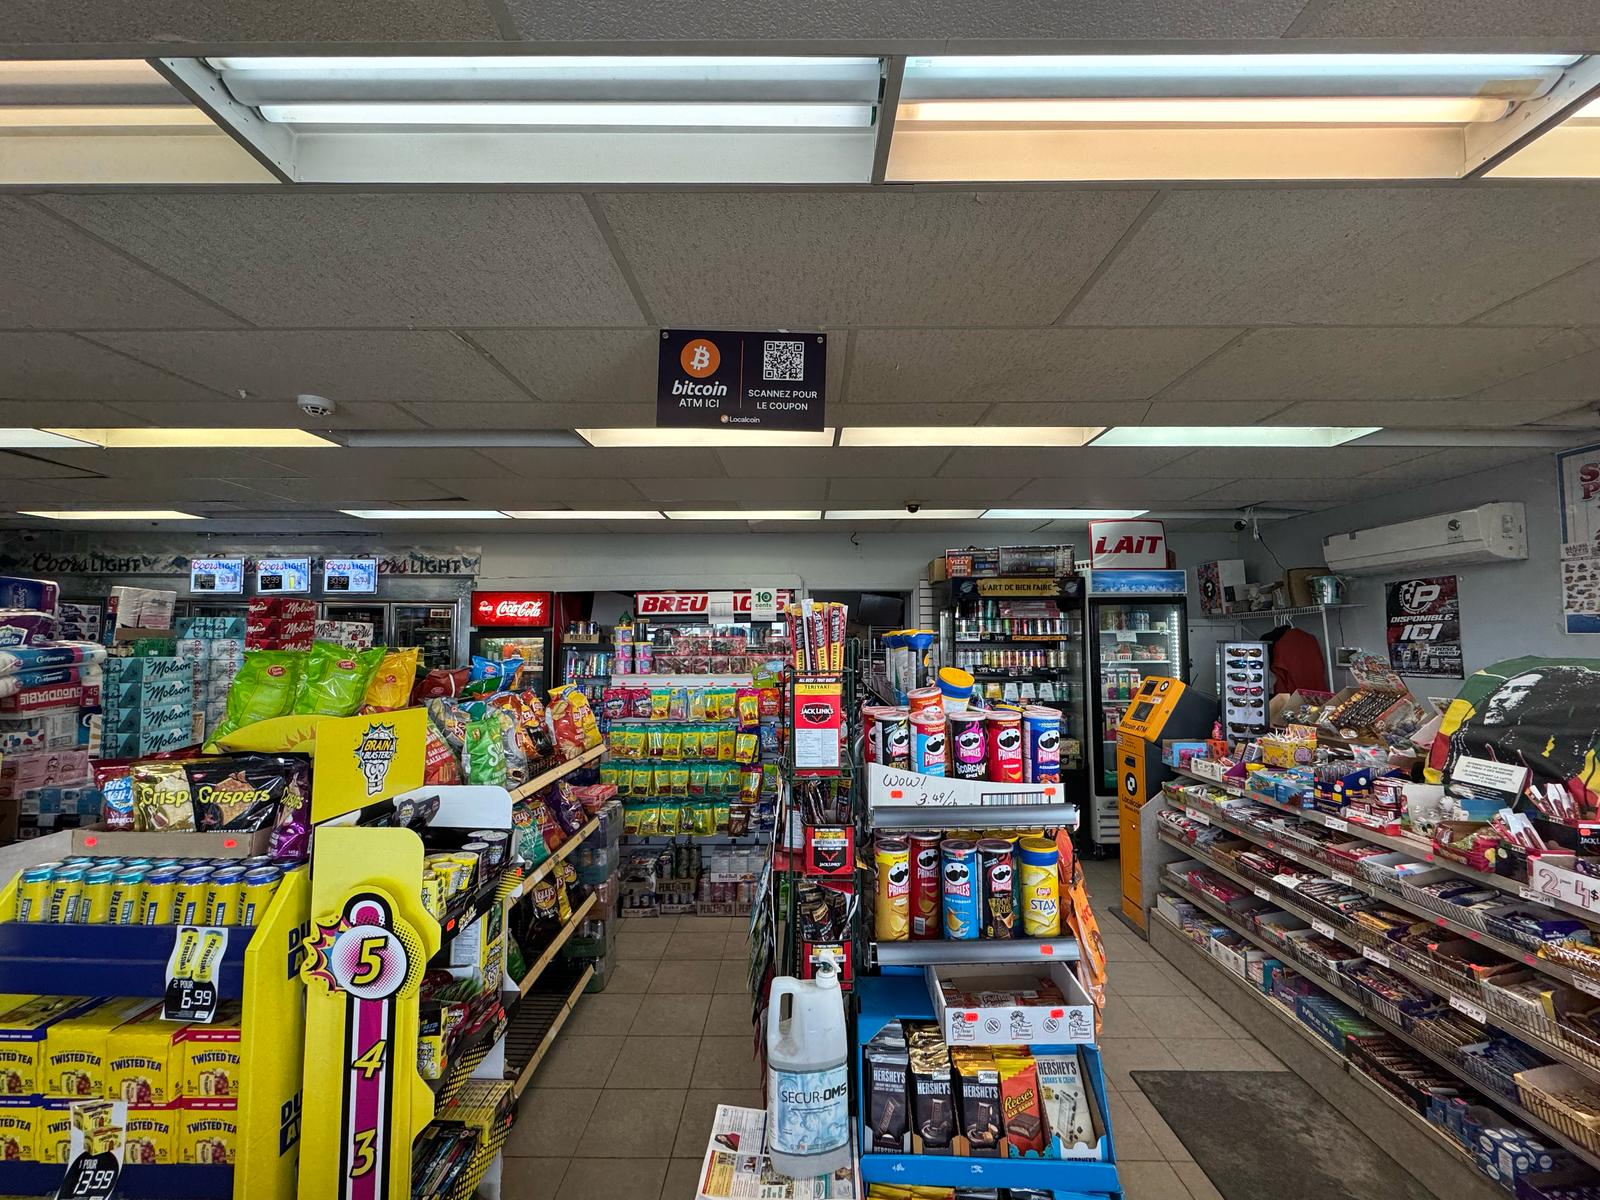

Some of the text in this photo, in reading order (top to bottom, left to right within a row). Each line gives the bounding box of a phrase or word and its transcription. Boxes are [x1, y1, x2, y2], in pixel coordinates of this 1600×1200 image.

[672, 380, 727, 396] bitcoin
[748, 390, 790, 398] SCANNEZ
[679, 398, 719, 408] ATM ICI
[770, 402, 808, 410] COUPON
[1095, 535, 1163, 554] LAIT
[32, 552, 141, 572] Coors LIGHT
[192, 560, 240, 570] Coors LIGHT
[258, 561, 306, 570] Coors LIGHT
[326, 561, 374, 570] Coors LIGHT
[377, 557, 461, 574] ors LIGHT
[756, 592, 772, 602] 10
[496, 600, 543, 617] Coca-Cola
[1391, 614, 1453, 623] DISPONIBLE
[1400, 624, 1443, 640] ICI
[150, 656, 191, 678] Molson
[148, 680, 190, 702] Molson
[148, 704, 190, 726] Molson
[1120, 721, 1148, 732] Bitcoin ATM
[148, 728, 190, 750] Molson
[364, 739, 391, 751] BRAIN
[364, 751, 394, 760] BLASTERZ
[104, 780, 124, 791] Bits
[141, 788, 189, 807] Crisp
[198, 786, 270, 807] Crispers
[945, 881, 970, 896] PRINGLES
[1539, 868, 1561, 898] 2
[1031, 900, 1056, 910] STAX
[350, 936, 388, 986] 5
[180, 980, 193, 988] POUR
[181, 990, 212, 1008] 6.99
[18, 1054, 32, 1065] TEA
[50, 1054, 101, 1066] TWISTED TEA
[191, 1053, 226, 1065] TWISTED
[351, 1039, 386, 1078] 4
[110, 1059, 162, 1072] TWISTED TEA
[1038, 1062, 1077, 1075] HERSHEY'S
[874, 1070, 906, 1084] HERSHEY'S
[917, 1082, 951, 1095] HERSHEY'S
[963, 1085, 998, 1098] HERSHEY'S
[1005, 1088, 1034, 1112] Reese's
[16, 1120, 31, 1132] TEA
[48, 1121, 71, 1134] TWIST
[154, 1122, 169, 1134] TEA
[187, 1121, 236, 1134] TWISTED TEA
[349, 1129, 376, 1178] 3
[83, 1159, 98, 1169] POUR
[73, 1170, 114, 1194] 13.99
